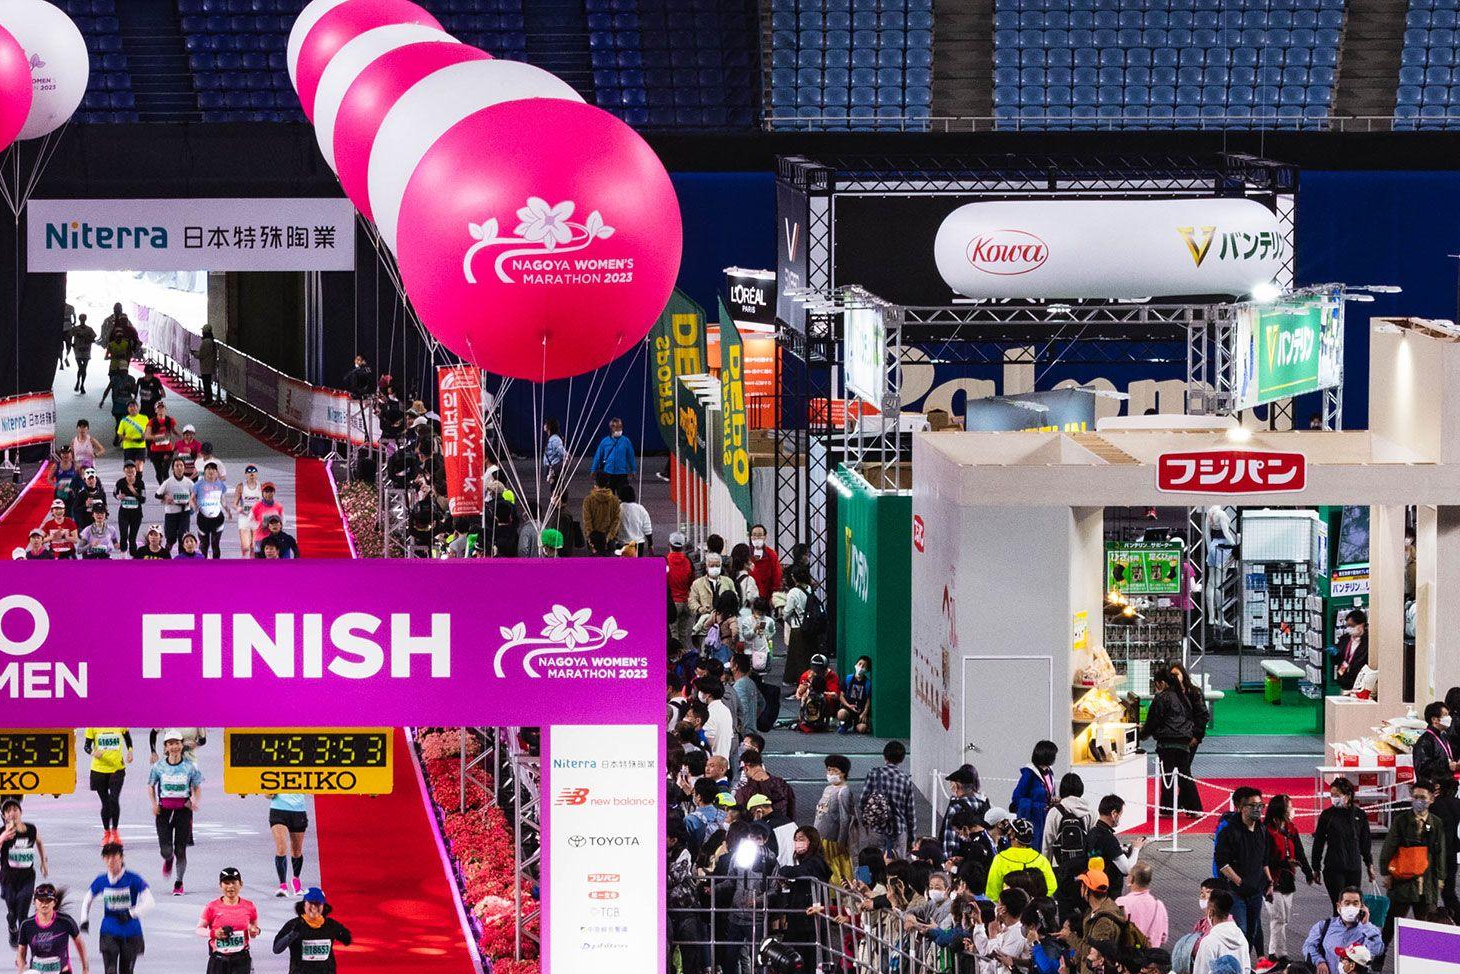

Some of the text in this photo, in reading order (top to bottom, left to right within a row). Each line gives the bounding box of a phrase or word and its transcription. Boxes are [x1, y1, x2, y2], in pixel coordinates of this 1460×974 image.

[46, 221, 336, 249] Niterra 日本特殊陶業
[971, 236, 1046, 263] Kowa
[512, 258, 634, 271] NAGOYA WOMEN'S
[523, 272, 633, 285] MARATHON 2023
[731, 284, 766, 306] L'ORÉAL
[742, 305, 756, 314] PARIS
[1167, 458, 1299, 486] フジパン
[142, 612, 451, 679] FINISH
[538, 657, 648, 667] NAGOYA WOMEN'S
[547, 669, 648, 679] MARATHON 2023
[554, 758, 654, 769] Niterra 日本特殊陶業
[260, 772, 357, 790] SEIKO
[613, 797, 655, 806] balance
[589, 836, 640, 846] TOYOTA
